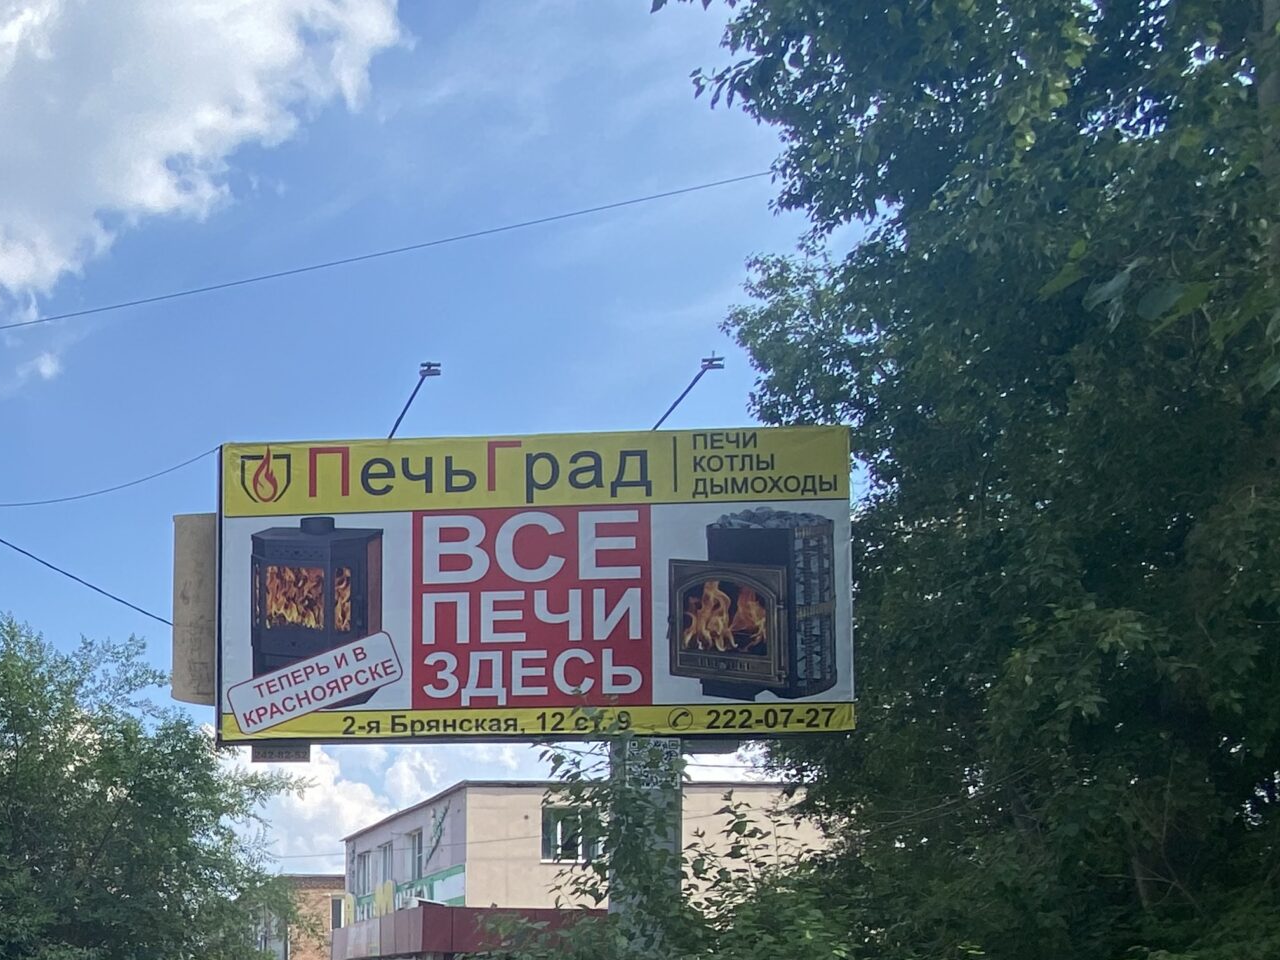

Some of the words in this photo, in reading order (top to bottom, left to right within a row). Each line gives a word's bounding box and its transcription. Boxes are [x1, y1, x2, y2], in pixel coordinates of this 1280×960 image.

[692, 431, 758, 450] ПЕЧИ
[692, 453, 775, 473] КОТЛЫ
[308, 440, 653, 504] ПечьГрад
[692, 474, 838, 498] ДЫМОХОДЫ
[422, 509, 642, 585] ВСЕ
[422, 587, 643, 645] ПЕЧИ
[242, 658, 398, 728] КРАСНОЯРСКЕ
[253, 661, 330, 698] ТЕПЕРЬ
[334, 652, 350, 670] И
[352, 646, 368, 662] В
[422, 648, 644, 707] ЗДЕСЬ
[341, 715, 381, 735] 2-я
[390, 712, 526, 737] Брянская,
[536, 711, 566, 731] 12
[617, 710, 632, 730] 9
[706, 707, 836, 730] 222-07-27
